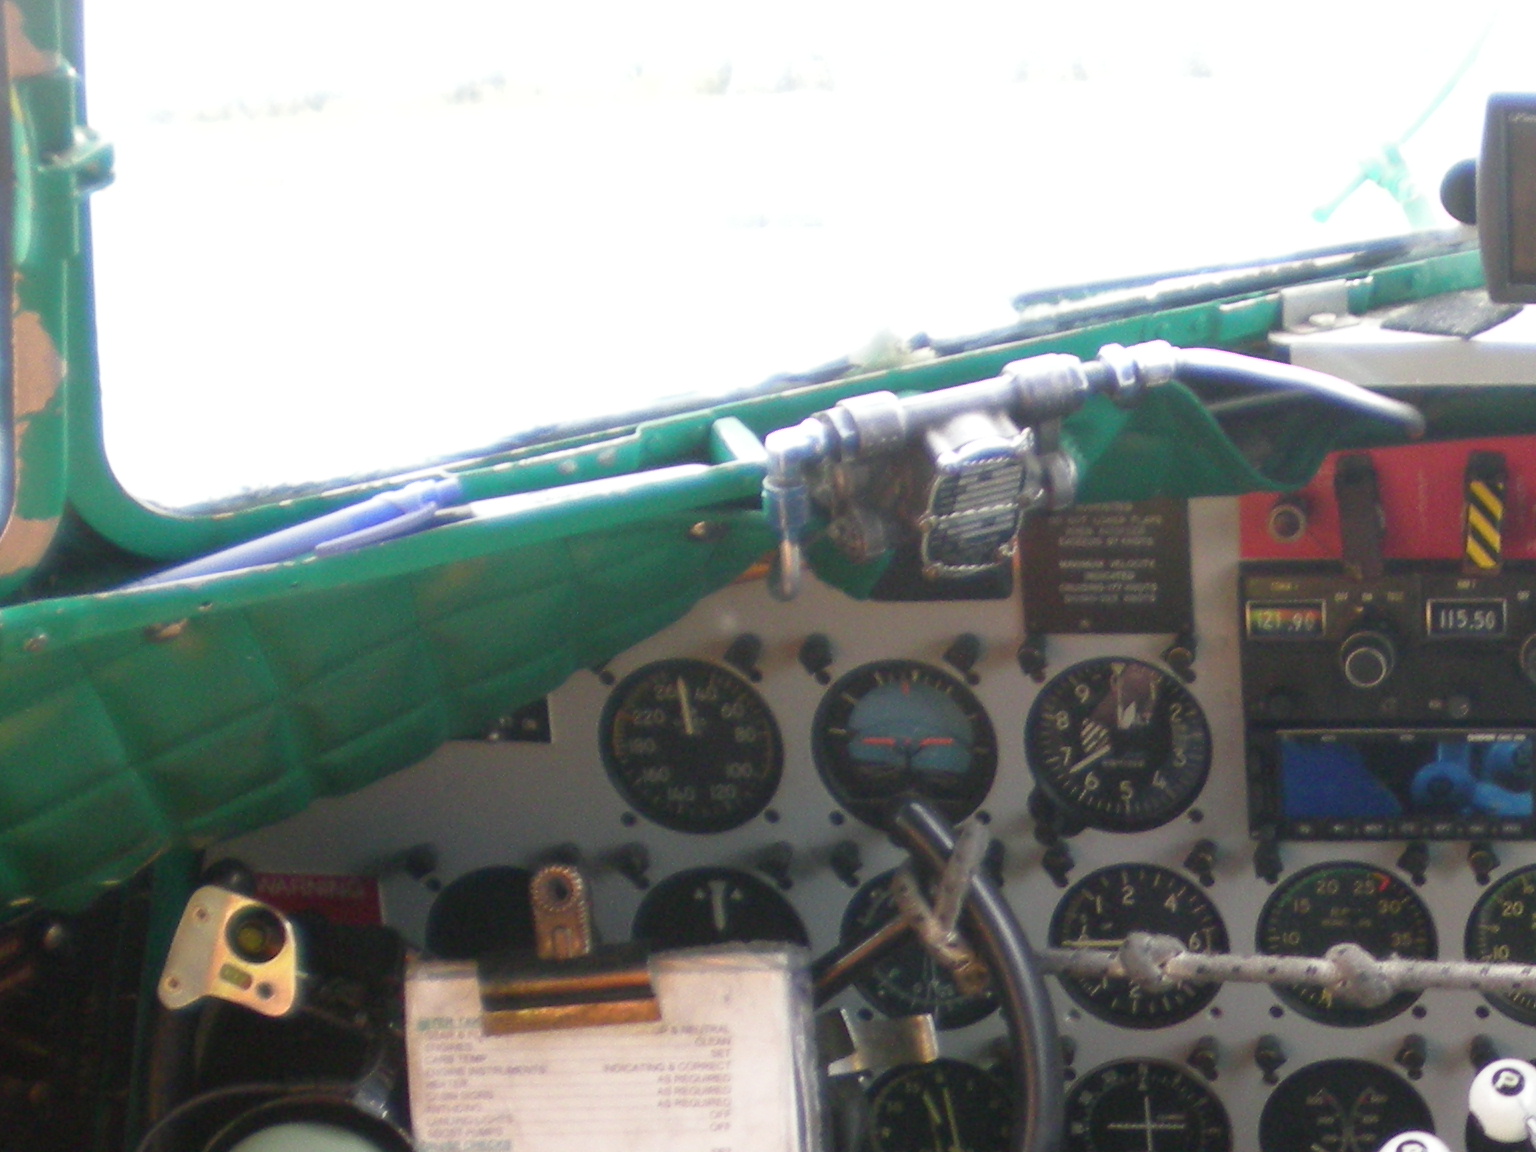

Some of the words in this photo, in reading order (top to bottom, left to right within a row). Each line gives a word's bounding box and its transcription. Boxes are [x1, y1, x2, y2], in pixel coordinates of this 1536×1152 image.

[1438, 608, 1496, 630] 115.50
[1074, 684, 1090, 703] 9
[1056, 710, 1069, 730] 8
[1084, 771, 1100, 791] 6
[1316, 879, 1340, 895] 20
[1502, 901, 1524, 917] 20
[678, 1060, 731, 1071] CORRECT
[1494, 1070, 1521, 1089] P
